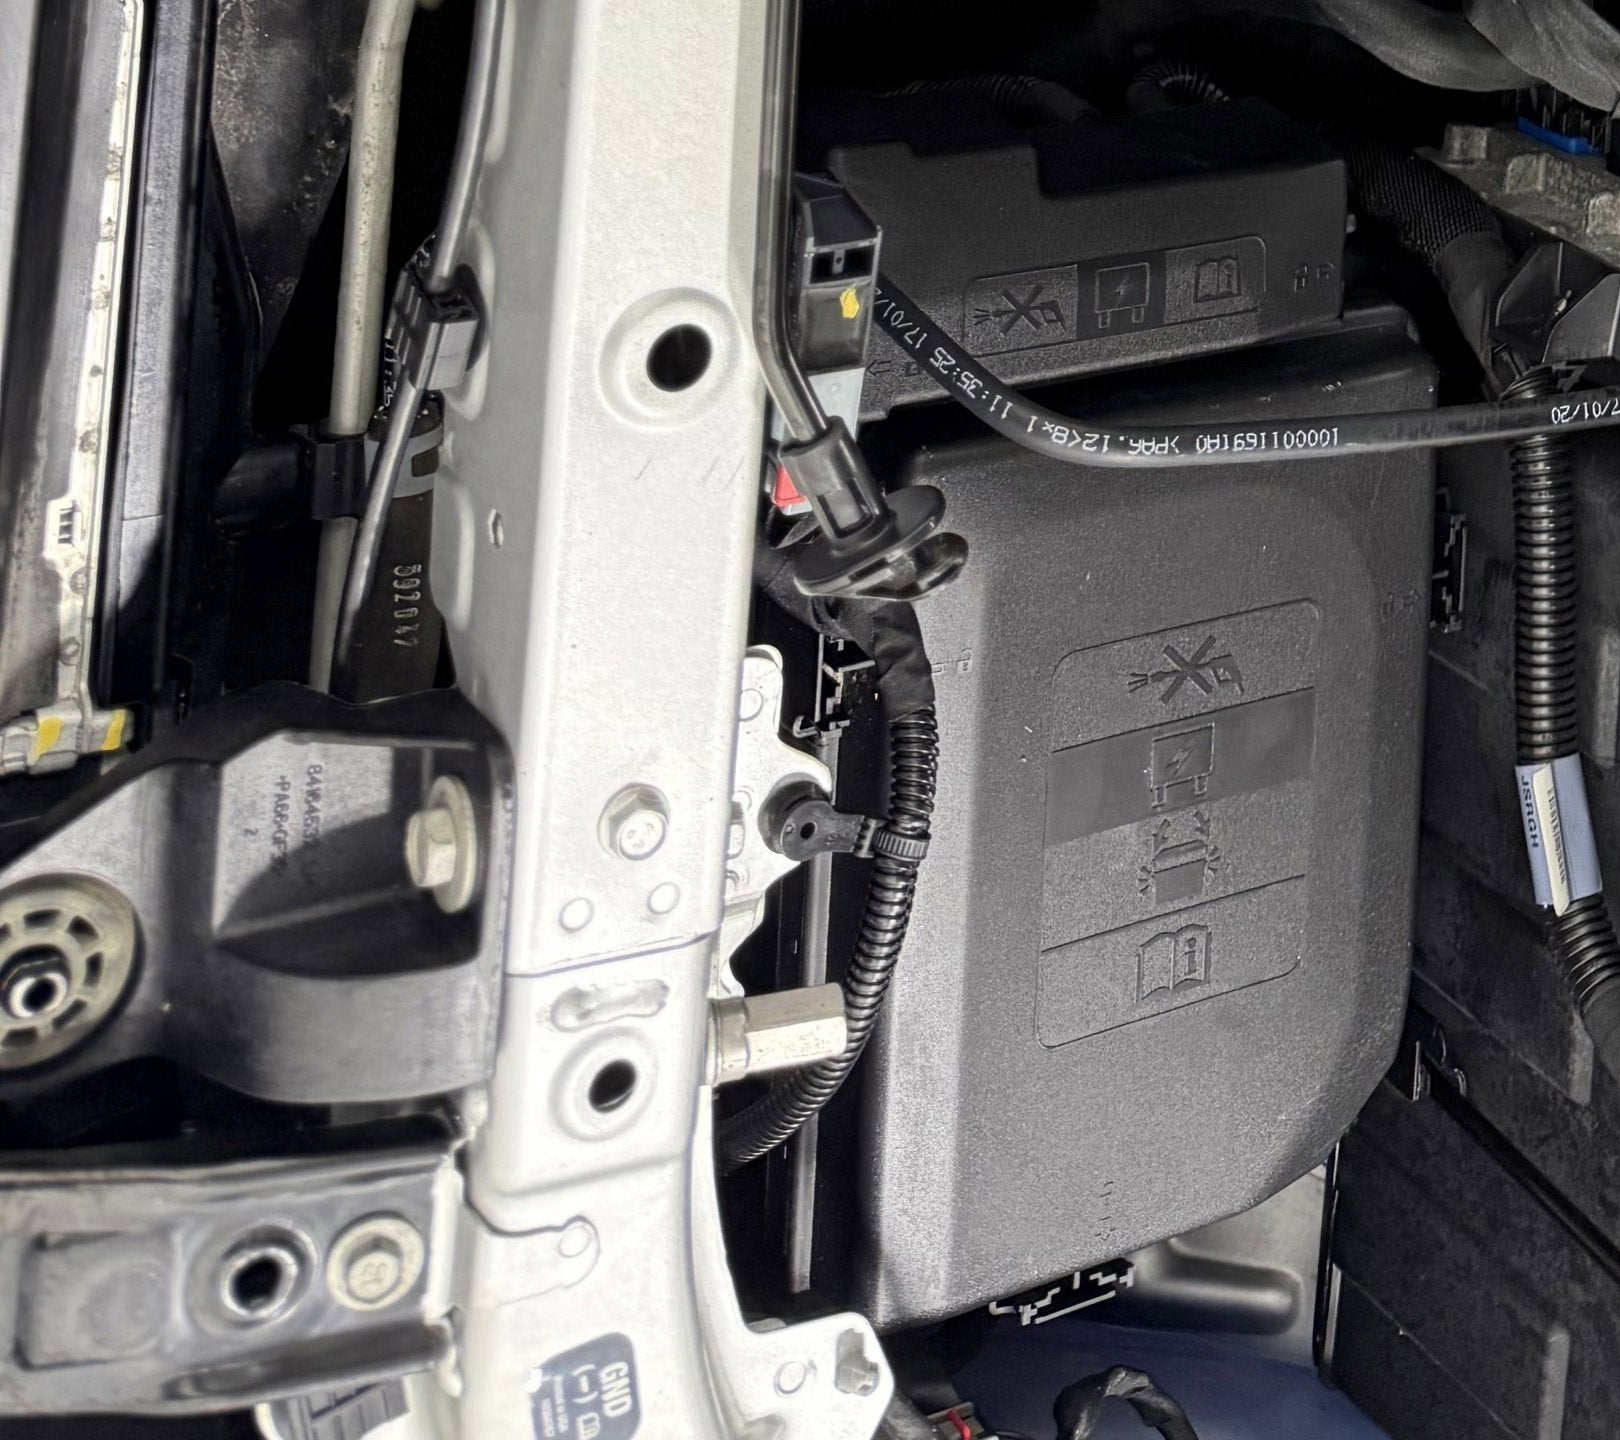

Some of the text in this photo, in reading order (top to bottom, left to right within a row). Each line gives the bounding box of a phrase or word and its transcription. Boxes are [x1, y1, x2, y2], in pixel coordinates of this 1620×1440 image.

[928, 346, 1014, 420] 11:35:25
[1521, 775, 1539, 848] JSRGH
[598, 1361, 632, 1418] GND
